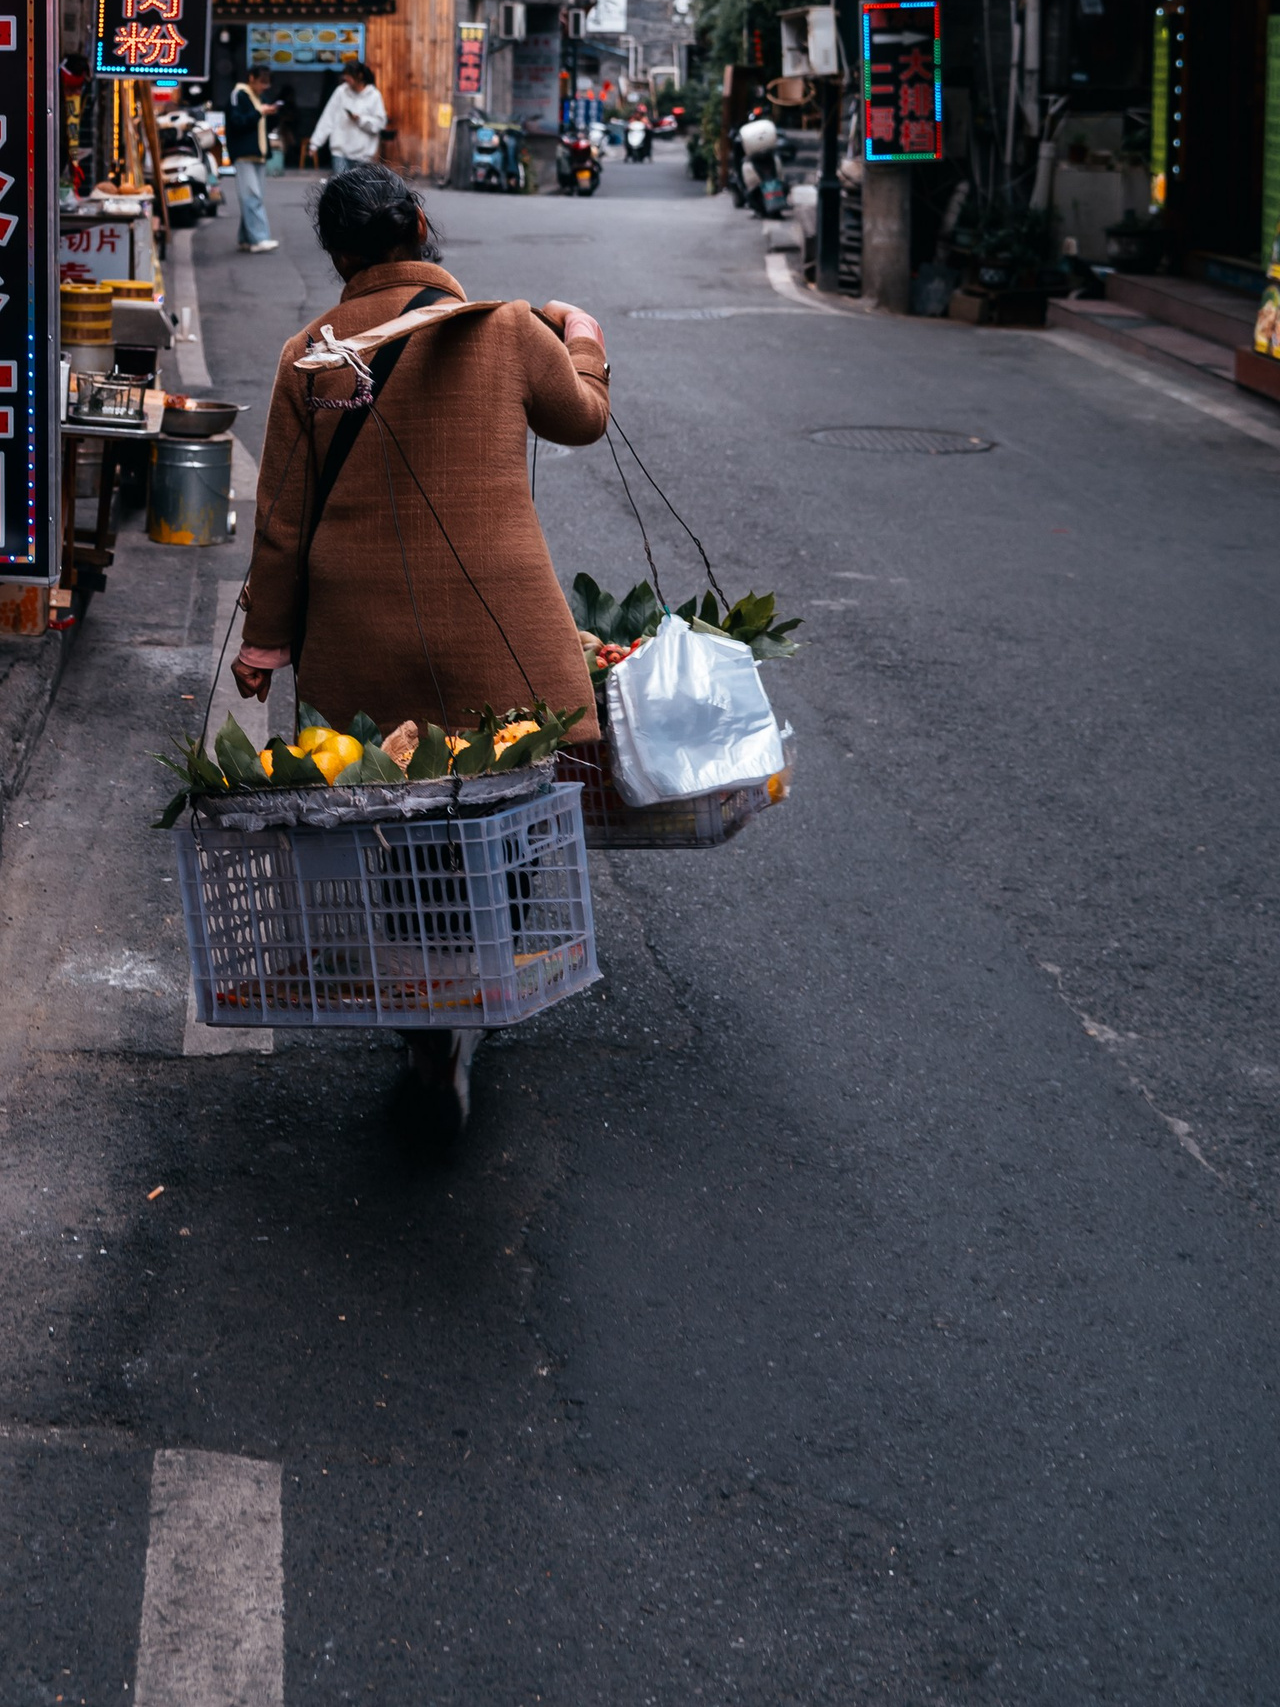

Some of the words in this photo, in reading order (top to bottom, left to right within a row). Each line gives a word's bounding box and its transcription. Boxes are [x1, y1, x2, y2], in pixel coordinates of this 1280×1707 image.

[898, 47, 933, 153] 大排档
[60, 228, 120, 253] 切片
